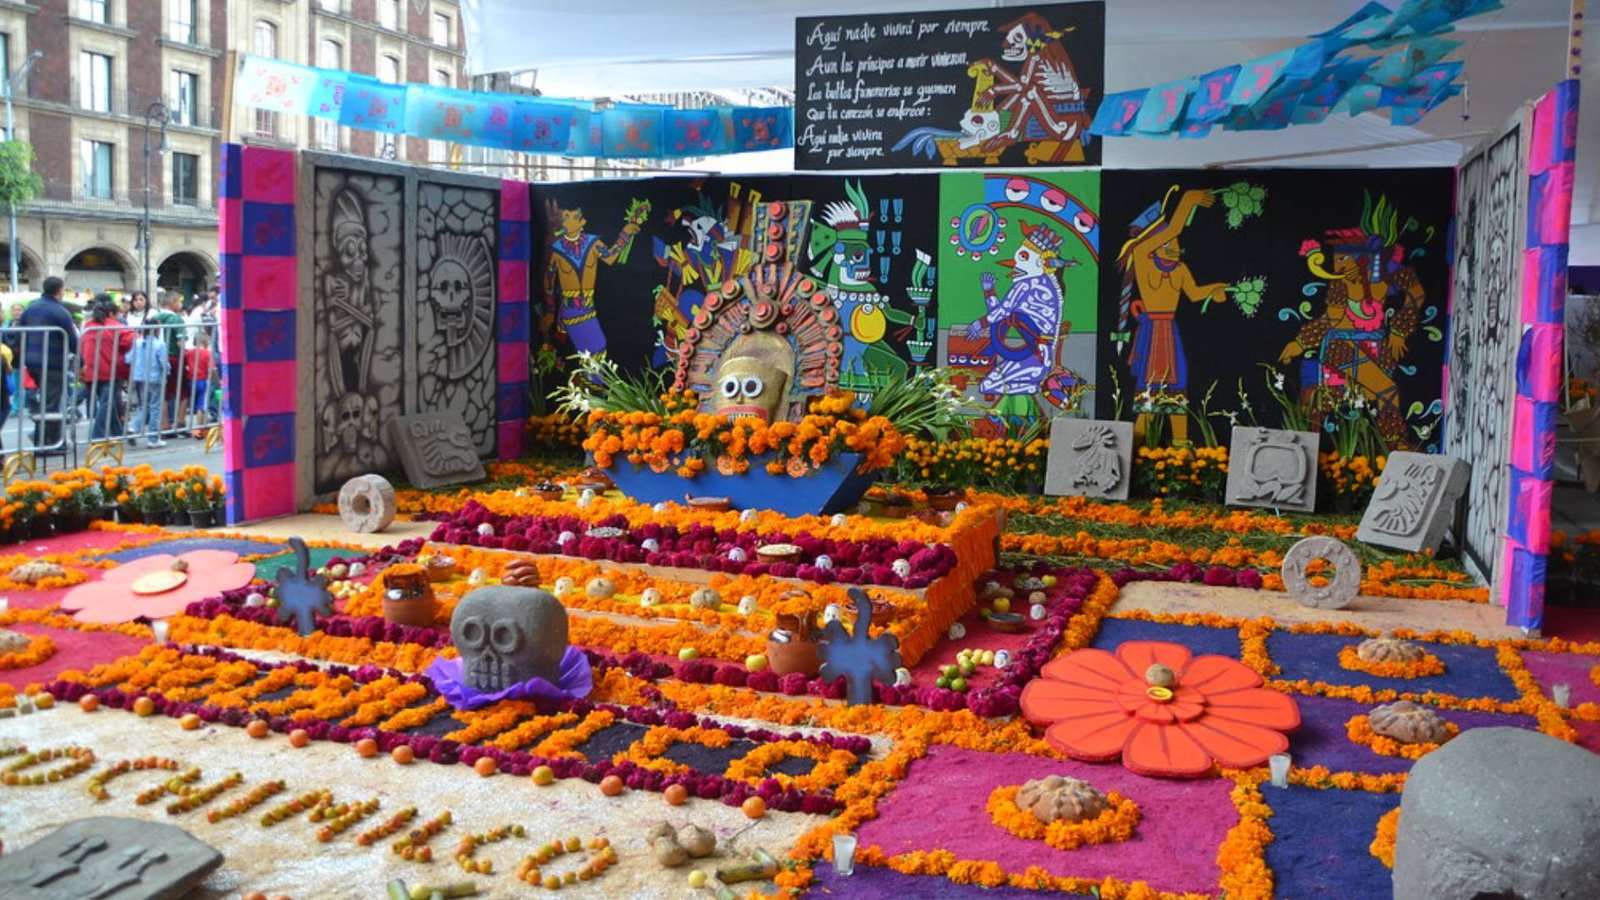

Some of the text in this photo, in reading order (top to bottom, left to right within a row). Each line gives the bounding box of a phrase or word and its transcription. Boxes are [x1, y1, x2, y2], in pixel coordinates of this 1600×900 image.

[806, 19, 990, 50] Aquí nadie vivirá por siempre.
[806, 54, 838, 77] Aun
[897, 58, 904, 69] a
[905, 53, 929, 69] morir
[903, 86, 913, 97] se
[827, 102, 838, 119] tu
[876, 107, 885, 118] se
[829, 124, 849, 146] nadie
[826, 148, 844, 164] por
[0, 745, 619, 889] OCHIMILCO
